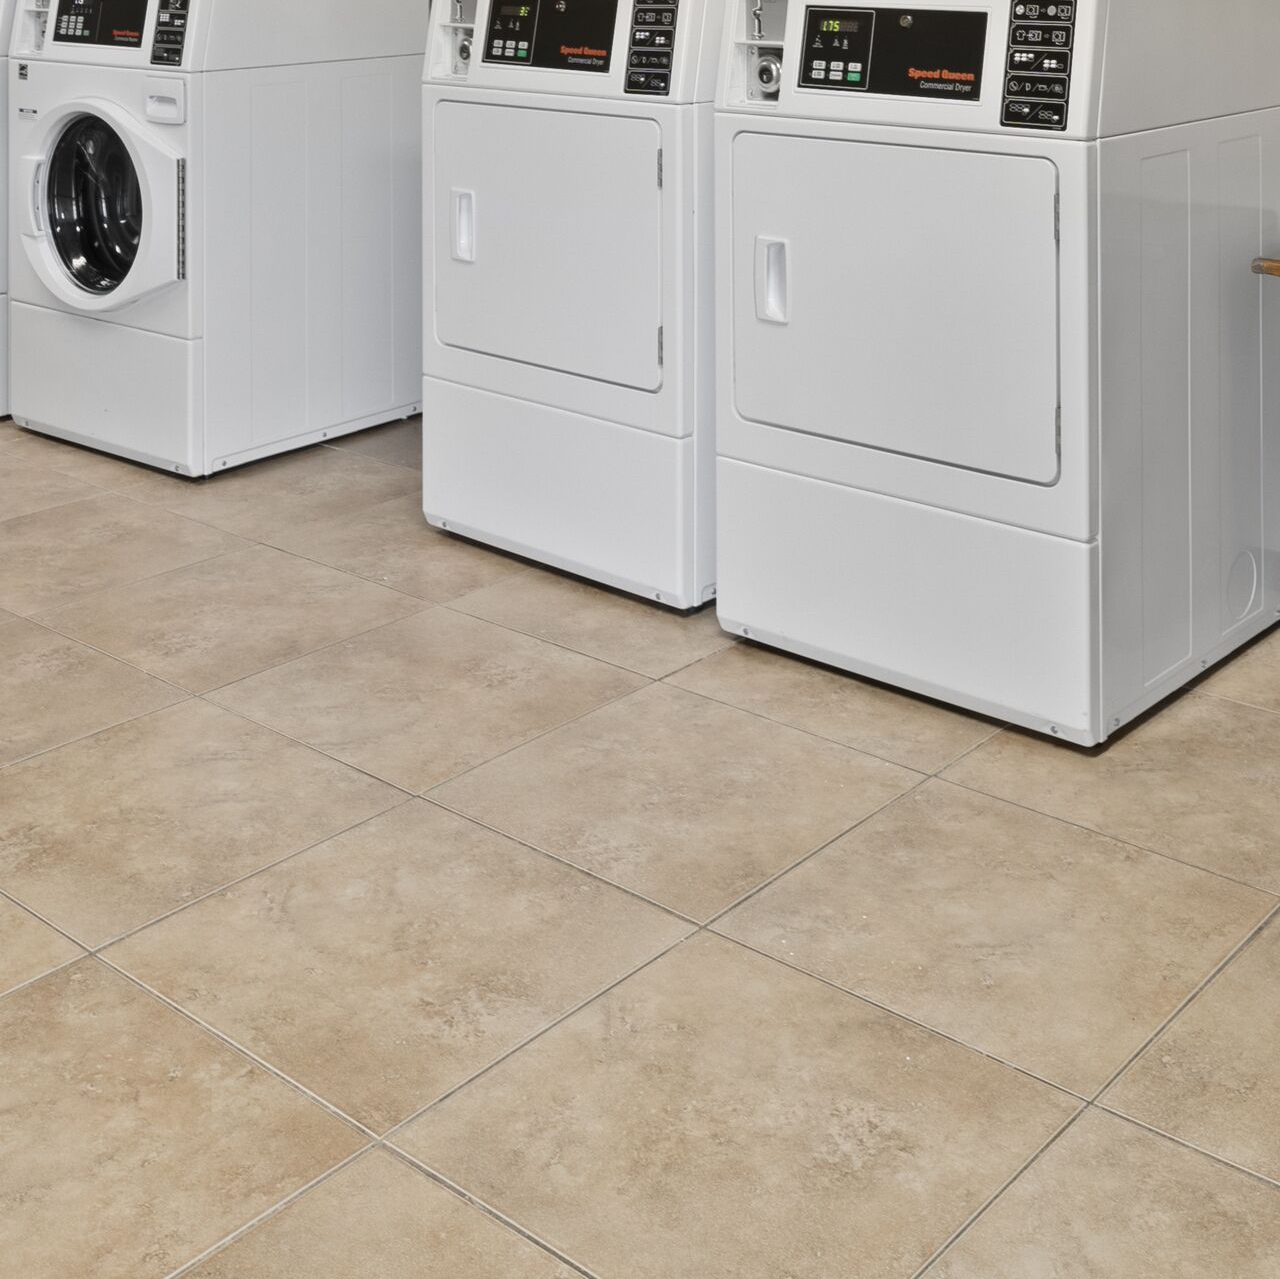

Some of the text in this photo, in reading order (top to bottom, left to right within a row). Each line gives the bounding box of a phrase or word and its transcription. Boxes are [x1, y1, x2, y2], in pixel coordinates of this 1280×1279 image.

[560, 45, 607, 57] Speed Queen
[568, 56, 604, 66] Commercial Dryer
[908, 67, 975, 81] Speed Queen
[920, 80, 972, 93] Commercial Dryer
